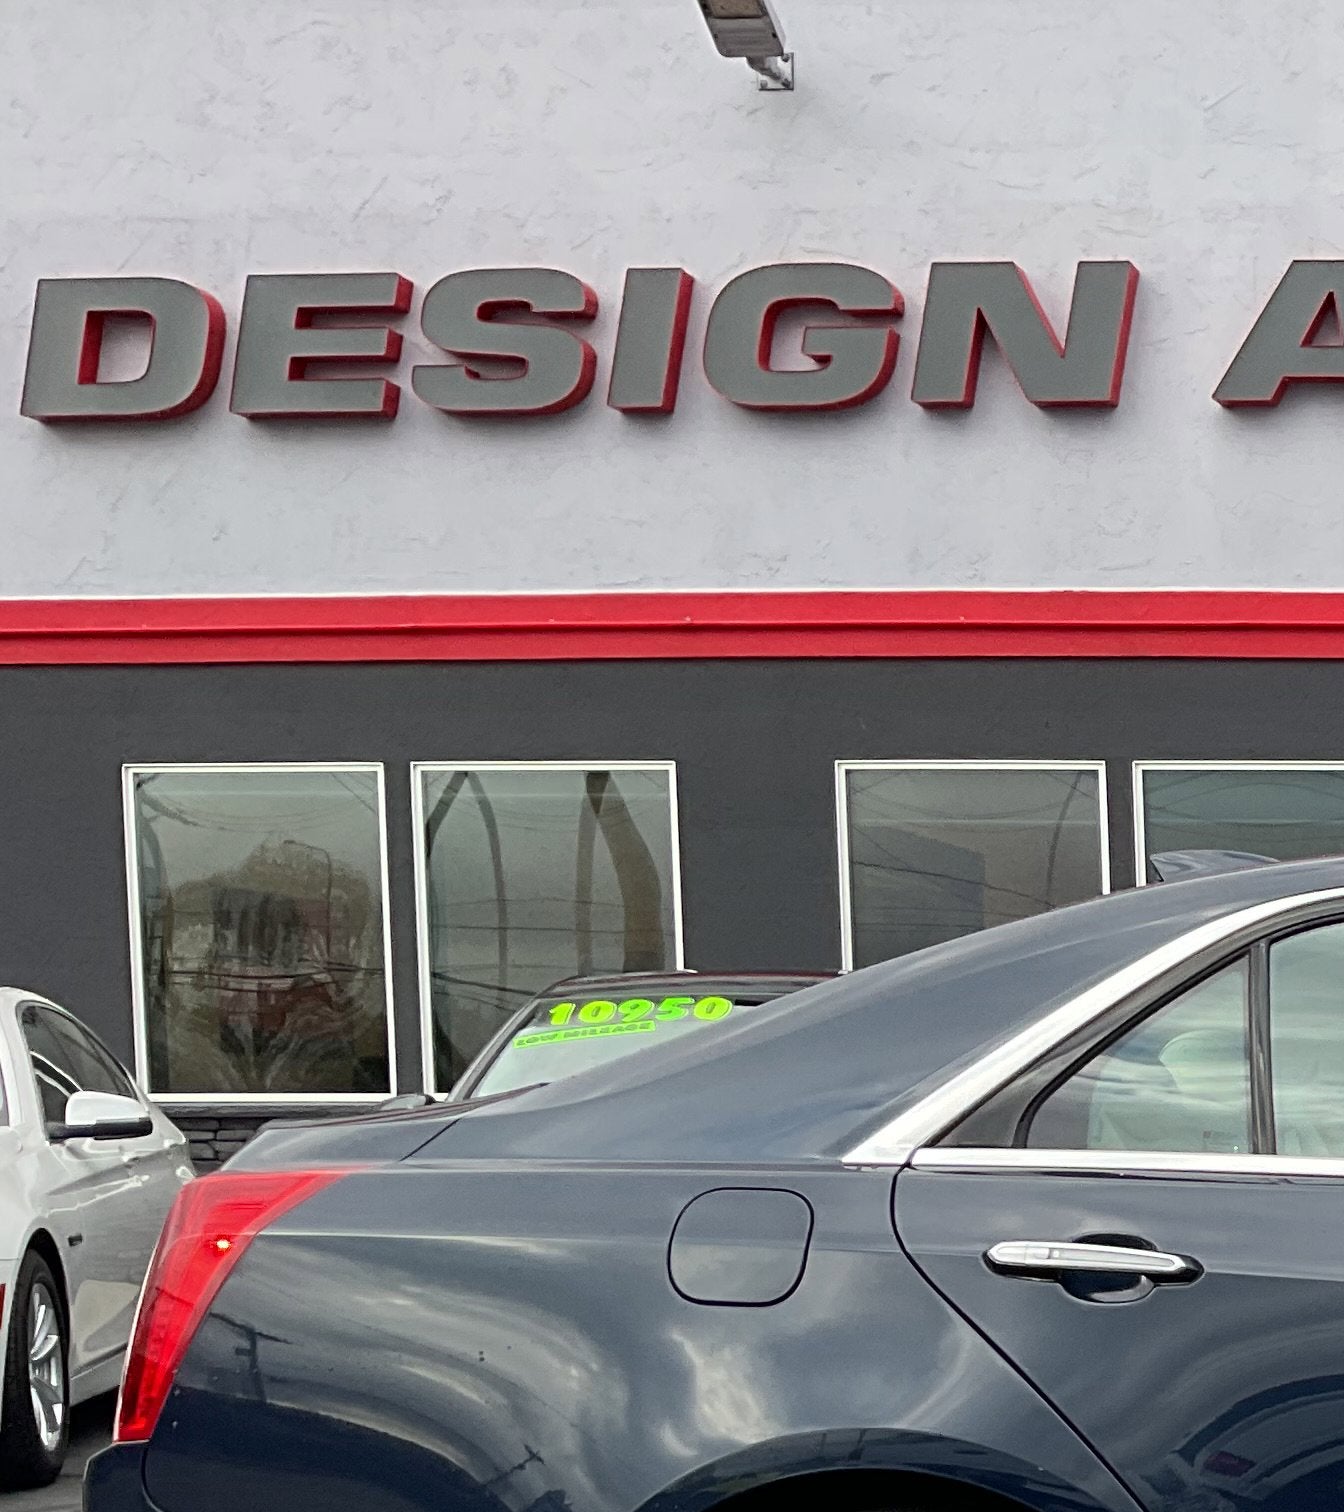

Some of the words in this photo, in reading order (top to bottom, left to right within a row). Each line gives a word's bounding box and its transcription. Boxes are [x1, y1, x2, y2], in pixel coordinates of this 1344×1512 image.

[20, 260, 1140, 422] DESIGN
[549, 995, 734, 1026] 10950
[515, 1032, 559, 1047] LOW
